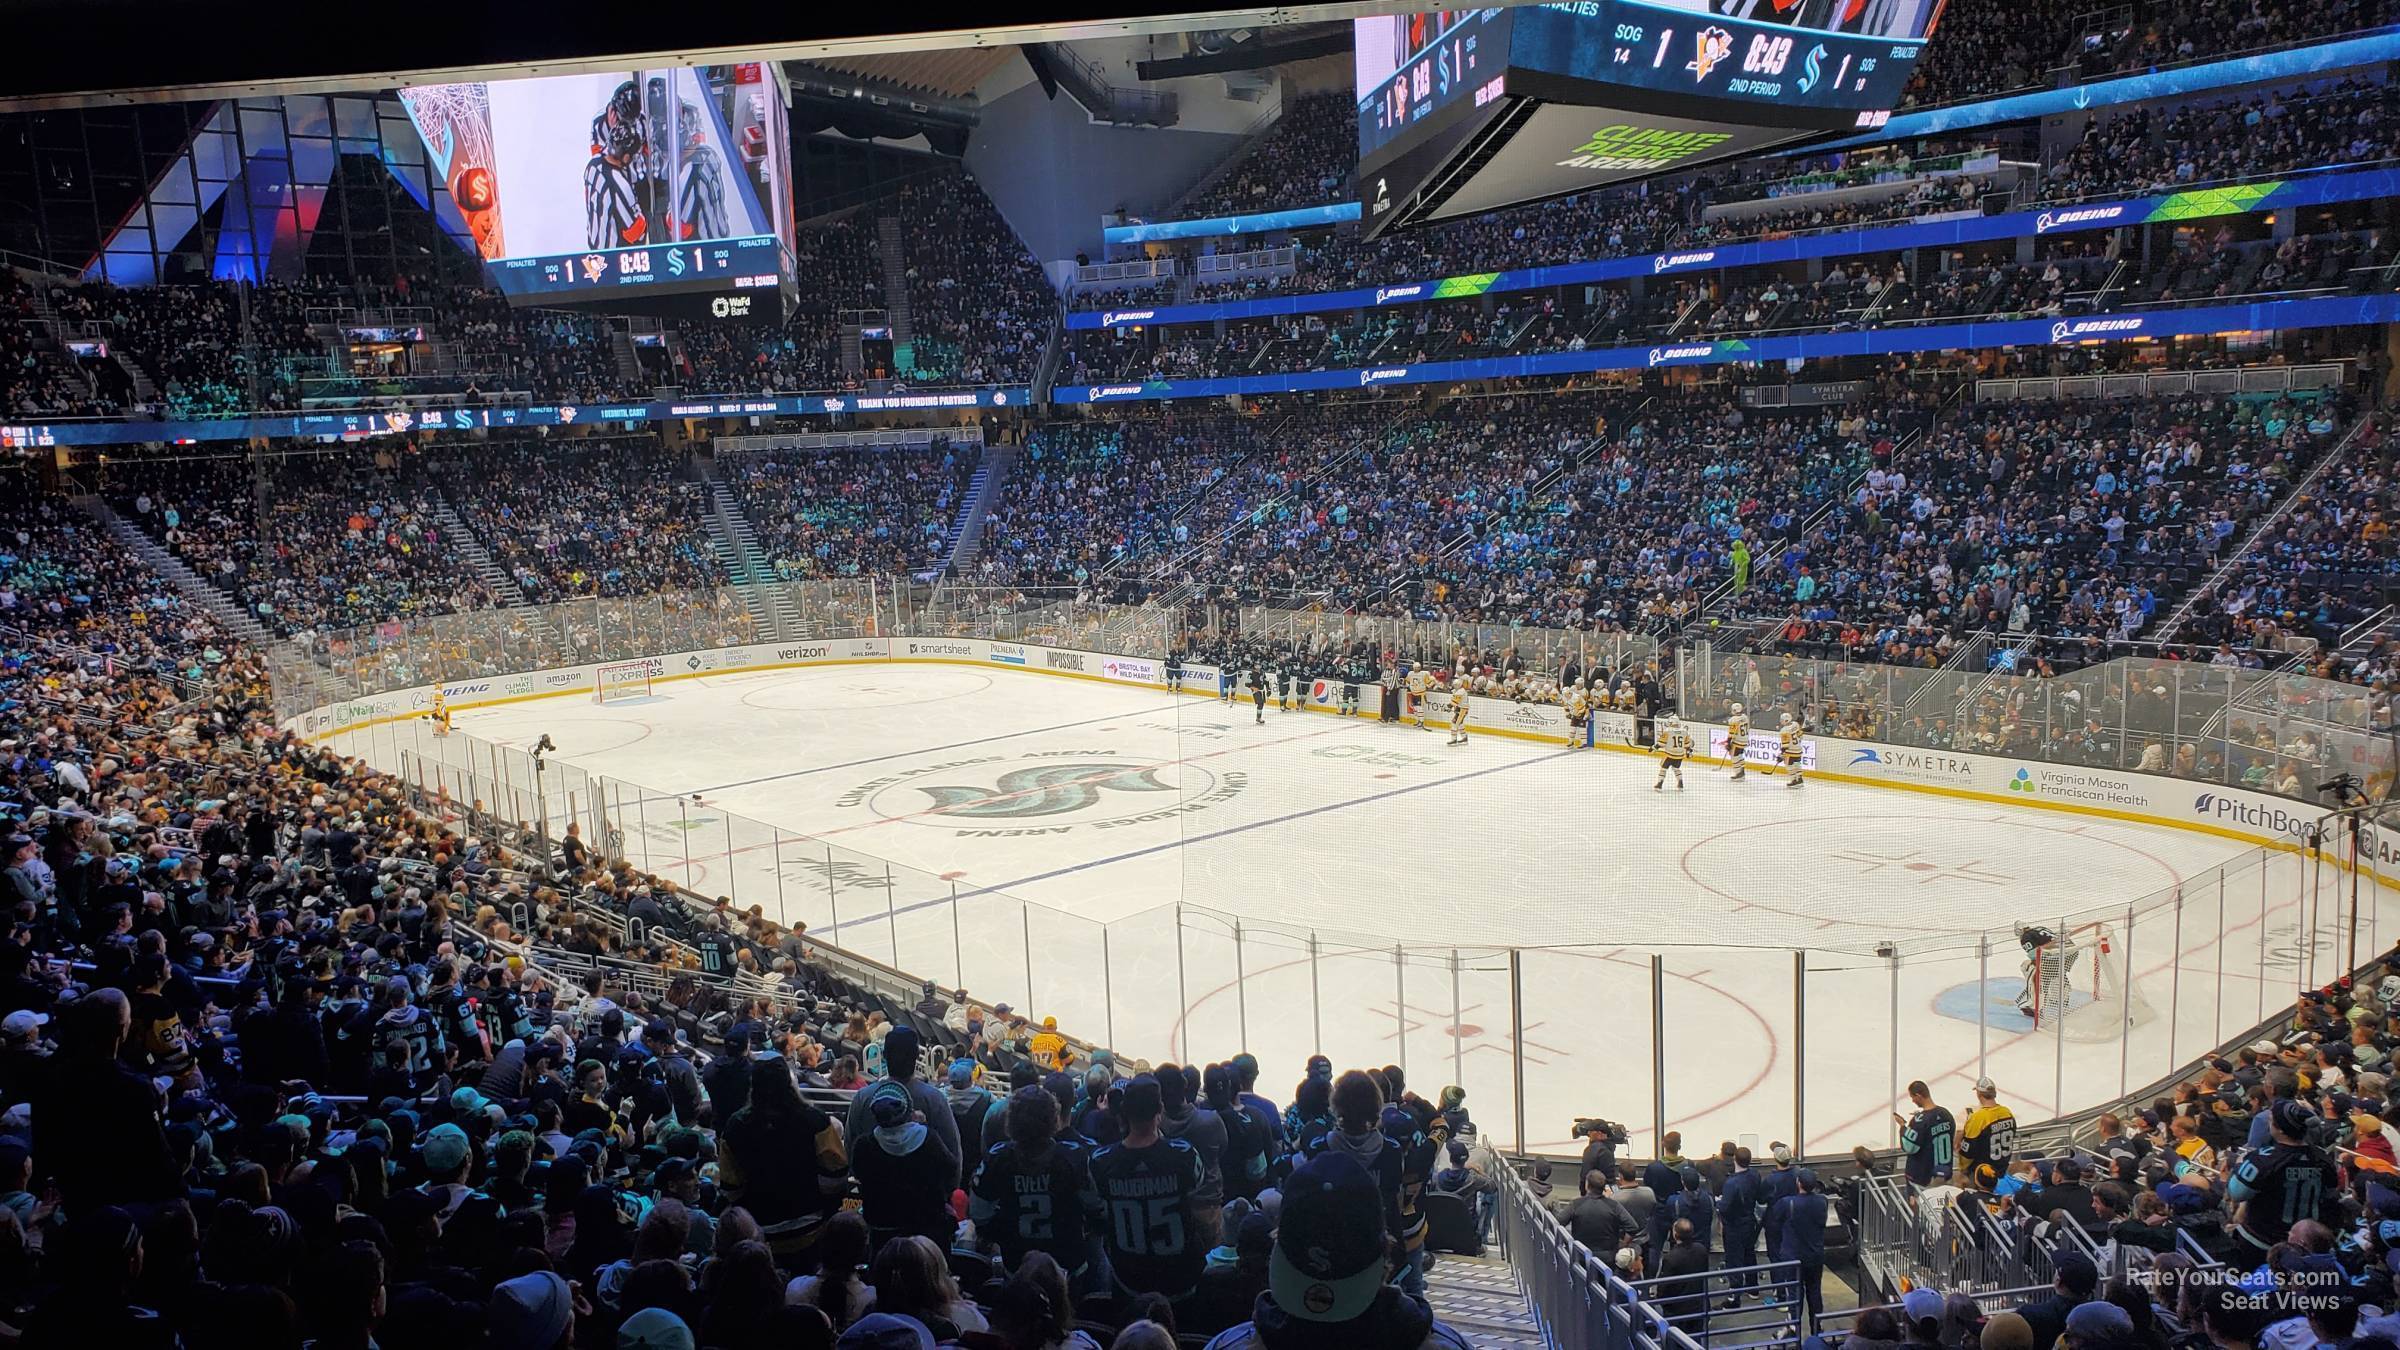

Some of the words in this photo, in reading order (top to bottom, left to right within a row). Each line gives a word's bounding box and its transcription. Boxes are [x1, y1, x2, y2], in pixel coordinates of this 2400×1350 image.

[1615, 24, 1643, 41] SOG
[1613, 48, 1630, 64] 14
[1652, 29, 1672, 68] 1
[1743, 34, 1793, 75] 8:43
[1890, 46, 1919, 58] PENALTIES
[1455, 39, 1460, 83] 1
[1859, 58, 1877, 72] SOG
[1833, 54, 1852, 89] 1
[1728, 79, 1749, 93] 2ND
[1749, 82, 1781, 96] PERIOD
[1387, 90, 1391, 128] 1
[1592, 125, 1734, 147] CLIMATE
[1571, 141, 1704, 159] PLEDGE
[1555, 155, 1671, 170] ARENA
[2056, 206, 2123, 223] BOEING
[738, 238, 771, 248] PENALTIES
[694, 248, 703, 272] 1
[714, 250, 729, 259] SOG
[1669, 252, 1714, 265] BOEING
[506, 259, 536, 268] PENALTIES
[545, 265, 559, 273] SOG
[620, 251, 650, 275] 8:43
[548, 274, 557, 282] 14
[565, 259, 574, 283] 1
[620, 275, 632, 284] 2ND
[632, 274, 654, 283] PERIOD
[1387, 286, 1421, 297] BOEING
[729, 297, 751, 307] WaFd
[731, 306, 749, 316] Bank
[1115, 312, 1154, 321] BOEING
[2072, 318, 2143, 333] BOEING
[1664, 347, 1712, 359] BOEING
[1371, 369, 1407, 379] BOEING
[1102, 386, 1141, 396] BOEING
[1811, 385, 1856, 394] SYMETRA
[1821, 392, 1845, 401] CLUB
[857, 399, 883, 409] THANK
[884, 398, 899, 408] YOU
[901, 396, 939, 407] FOUNDING
[939, 395, 977, 406] PARTNERS
[368, 415, 375, 431] 1
[482, 410, 490, 426] 1
[777, 645, 827, 660] verizon
[921, 642, 972, 655] smartsheet
[1046, 651, 1085, 672] IMPOSSIBLE
[1119, 662, 1139, 671] BRISTOL
[546, 671, 581, 685] amazon
[612, 667, 664, 682] EXPRESS
[1120, 670, 1133, 678] WILD
[1132, 671, 1154, 680] MARKET
[1182, 669, 1214, 681] OEING
[442, 683, 490, 697] OEING
[376, 700, 399, 714] Bank
[1506, 716, 1549, 726] MUCKLESHOOT
[1672, 735, 1683, 748] 16
[1744, 749, 1770, 760] WILD
[1884, 751, 1972, 775] SYMETRA
[835, 776, 900, 808] CLIMATE
[899, 755, 1006, 776] PLEDGE
[1021, 750, 1117, 758] ARENA
[2041, 770, 2085, 787] Virginia
[2088, 776, 2129, 791] Mason
[2041, 783, 2104, 801] Franciscan
[2107, 791, 2148, 807] Health
[1091, 803, 1208, 830] PLEDGE
[2217, 798, 2331, 843] PitchBook
[955, 825, 1073, 838] ARENA
[702, 950, 721, 970] 10
[2382, 985, 2395, 996] 10
[161, 1022, 180, 1042] 87
[485, 1014, 503, 1046] 13
[1932, 1133, 1951, 1167] 10
[1990, 1130, 2013, 1160] 69
[1015, 1174, 1050, 1193] EVELY
[1108, 1174, 1178, 1197] BAUGHMAN
[2282, 1179, 2322, 1224] 10
[1018, 1194, 1053, 1239] 2
[1112, 1198, 1185, 1256] 05
